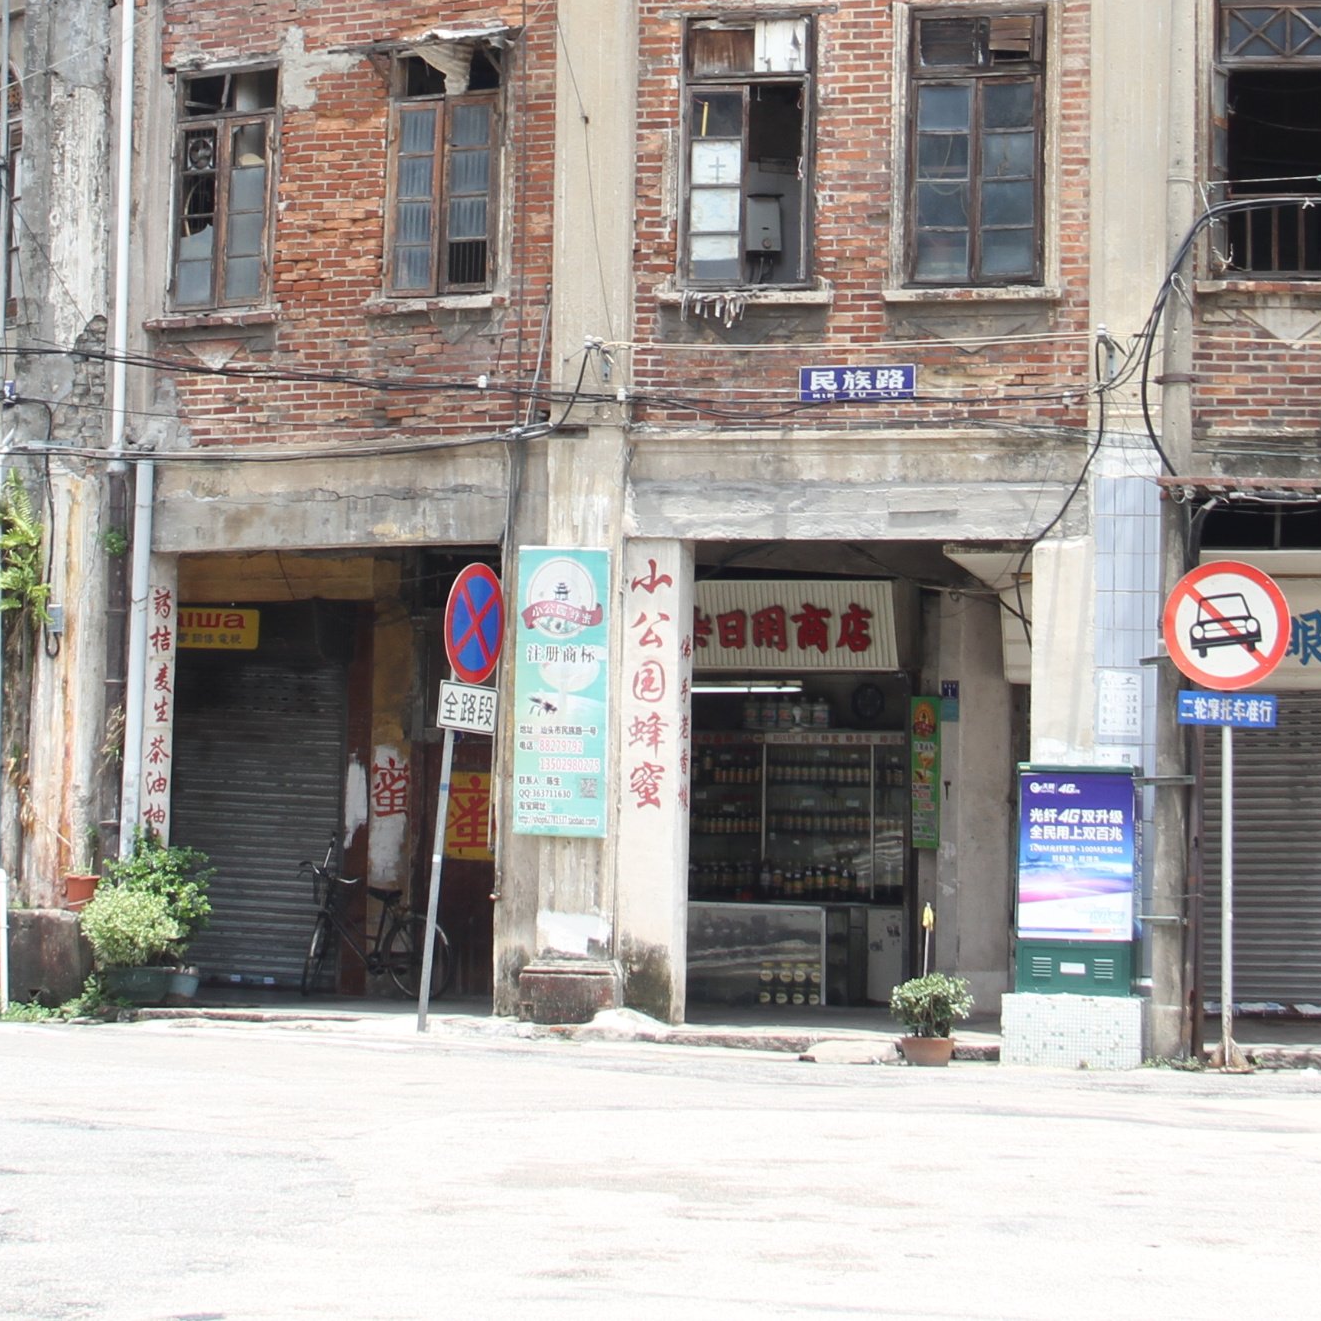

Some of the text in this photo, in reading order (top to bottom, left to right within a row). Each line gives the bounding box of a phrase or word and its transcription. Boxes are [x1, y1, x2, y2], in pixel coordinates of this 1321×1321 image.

[810, 369, 905, 391] 民族路
[527, 645, 595, 663] 注册商标
[443, 690, 493, 727] 全路段
[1181, 697, 1273, 724] 二轮摩托车准行
[539, 739, 583, 752] 88279792
[1030, 808, 1123, 825] 光纤4G双升级
[1030, 825, 1123, 841] 全民用上双百兆
